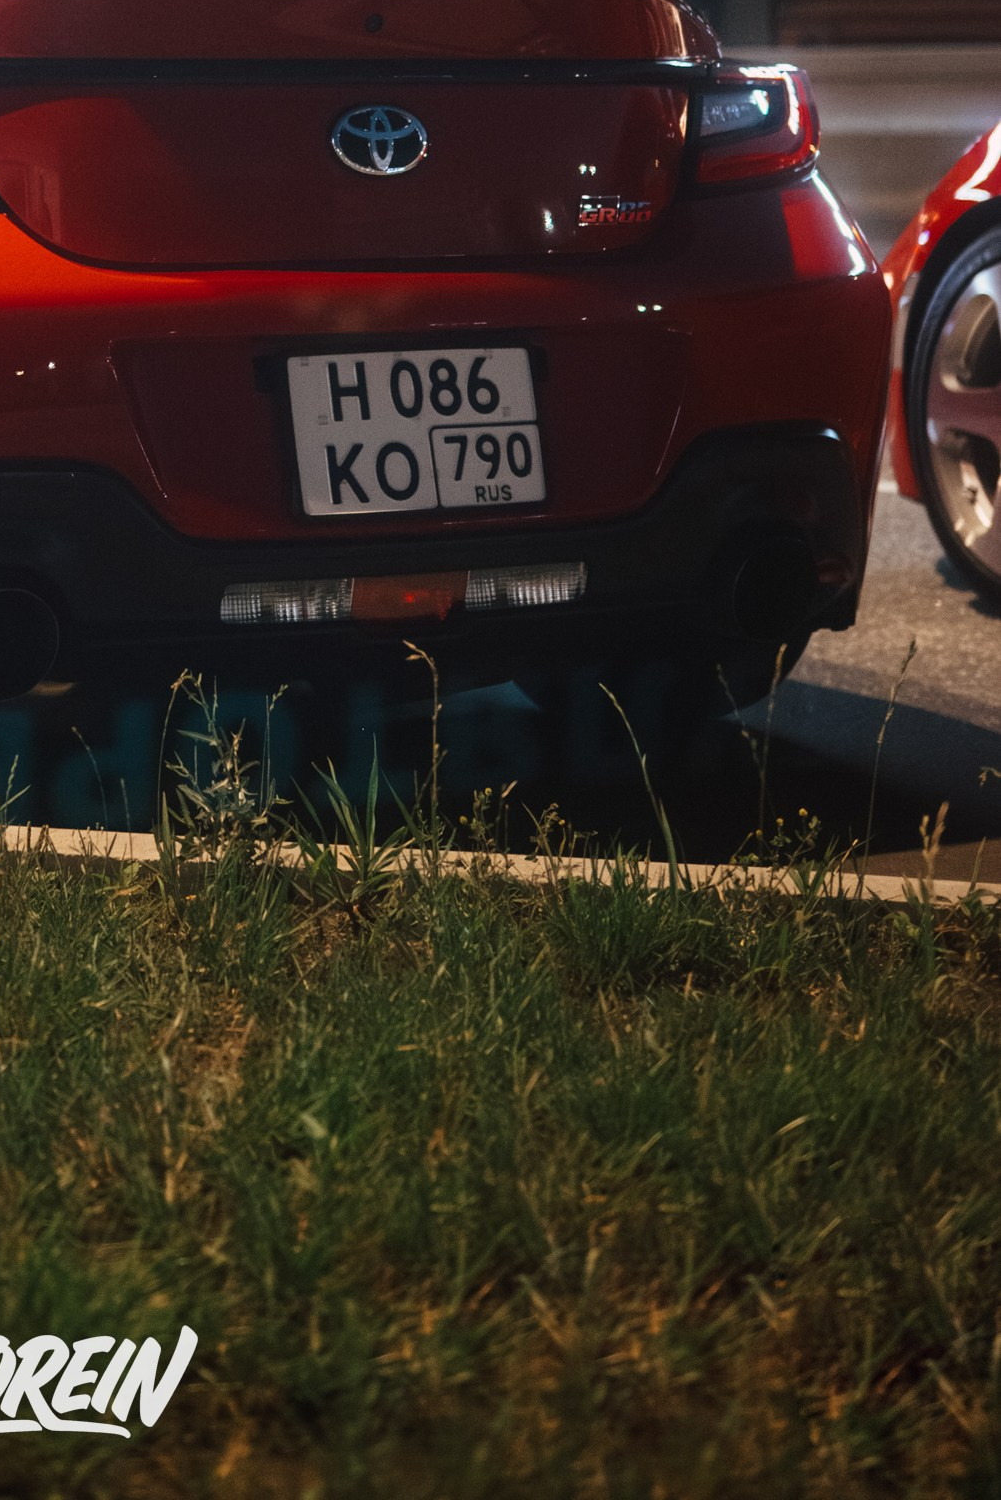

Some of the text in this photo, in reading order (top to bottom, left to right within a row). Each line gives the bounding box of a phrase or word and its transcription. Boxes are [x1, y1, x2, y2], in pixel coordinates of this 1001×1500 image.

[390, 356, 500, 418] 086
[444, 432, 532, 481] 790
[475, 484, 512, 503] RUS
